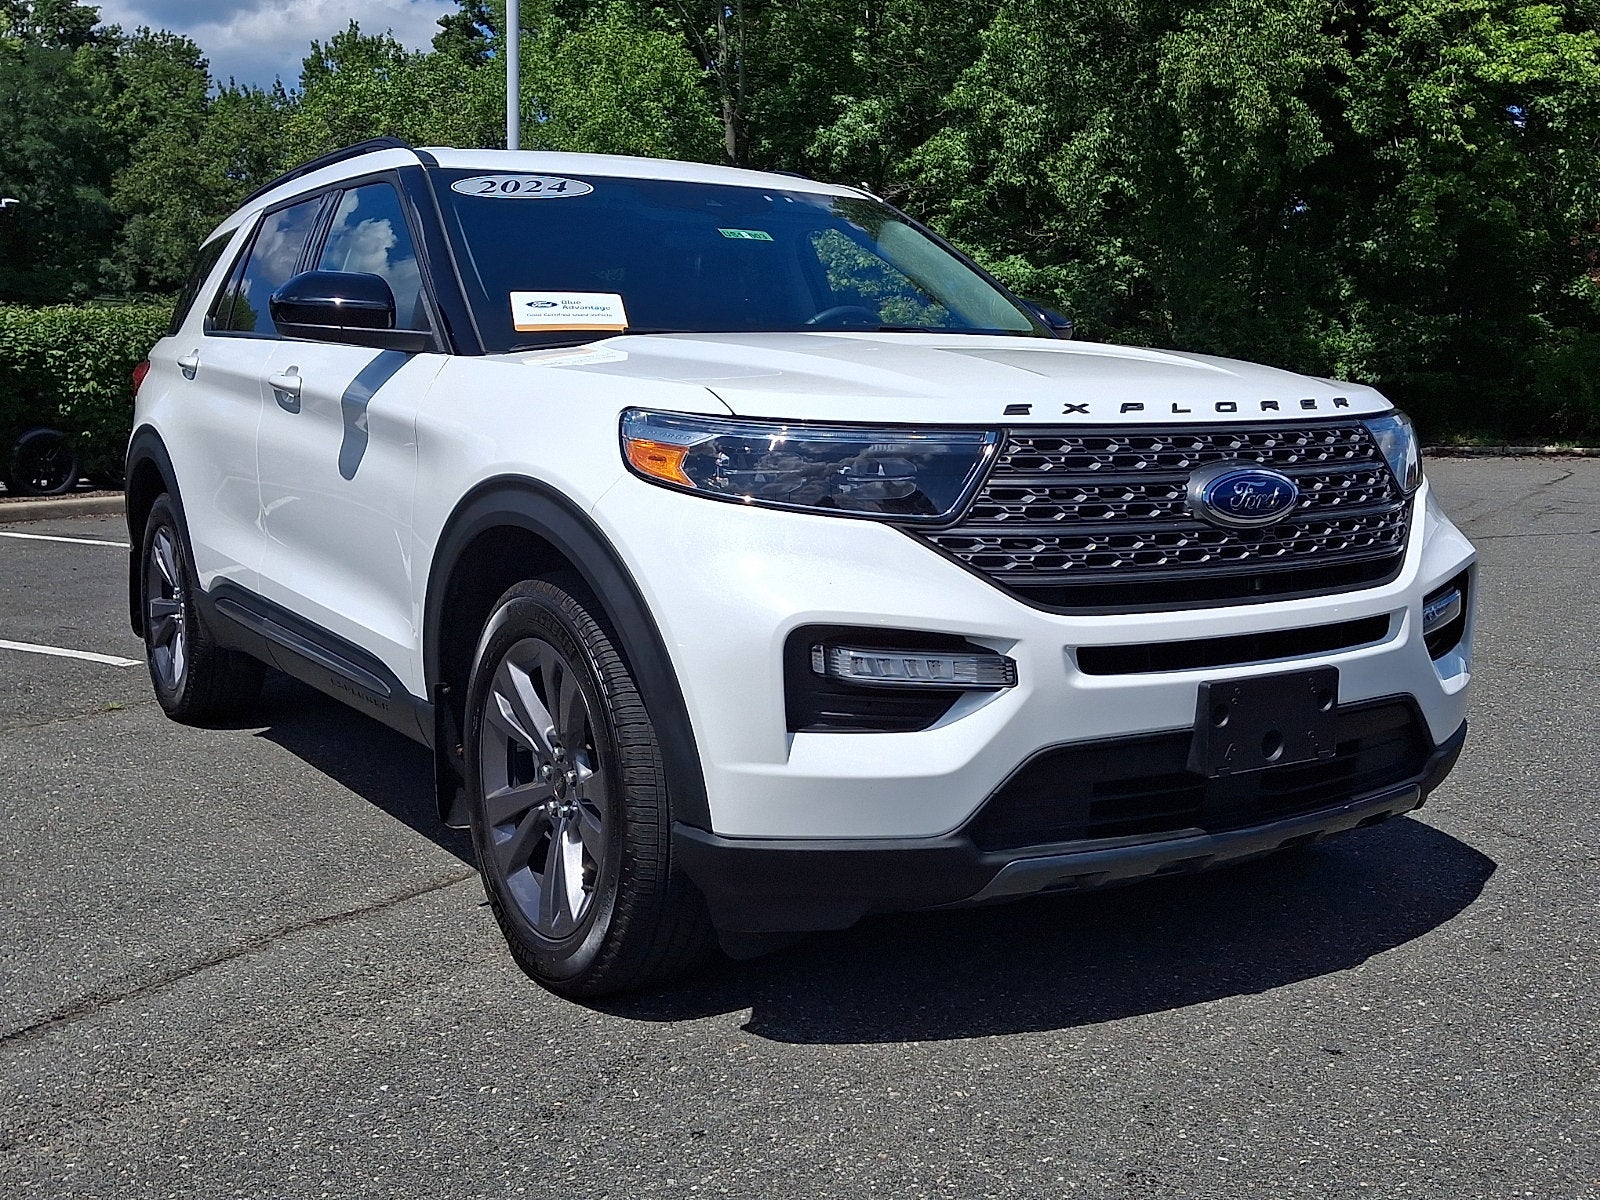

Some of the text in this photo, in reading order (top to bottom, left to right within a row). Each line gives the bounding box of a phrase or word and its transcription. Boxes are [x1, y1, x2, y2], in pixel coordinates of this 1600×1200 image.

[477, 179, 568, 194] 2024
[562, 304, 611, 312] Advantage
[1002, 396, 1350, 416] EXPLORER
[1229, 481, 1280, 511] Ford
